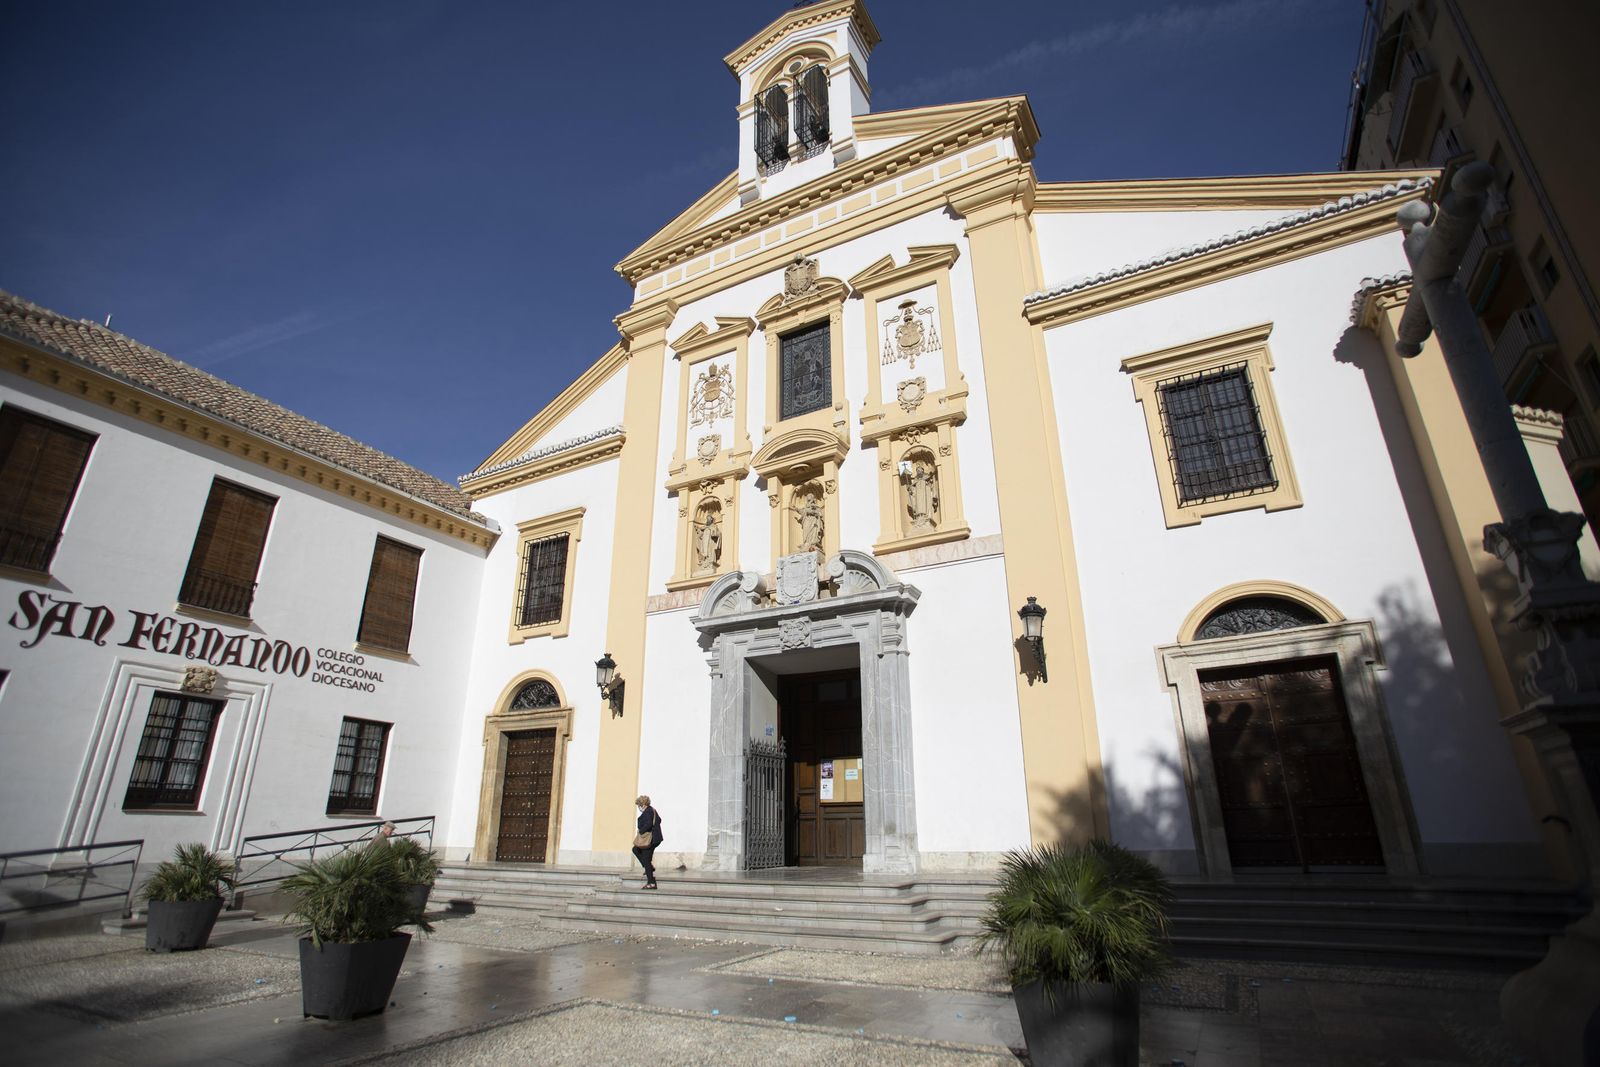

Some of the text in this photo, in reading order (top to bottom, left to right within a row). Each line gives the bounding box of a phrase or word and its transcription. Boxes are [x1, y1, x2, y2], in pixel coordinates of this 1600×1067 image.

[8, 590, 311, 678] SAN FERNANDO
[317, 647, 364, 665] COLEGIO
[316, 659, 384, 682] VOCACIONAL
[311, 672, 375, 693] DIOCESANO
